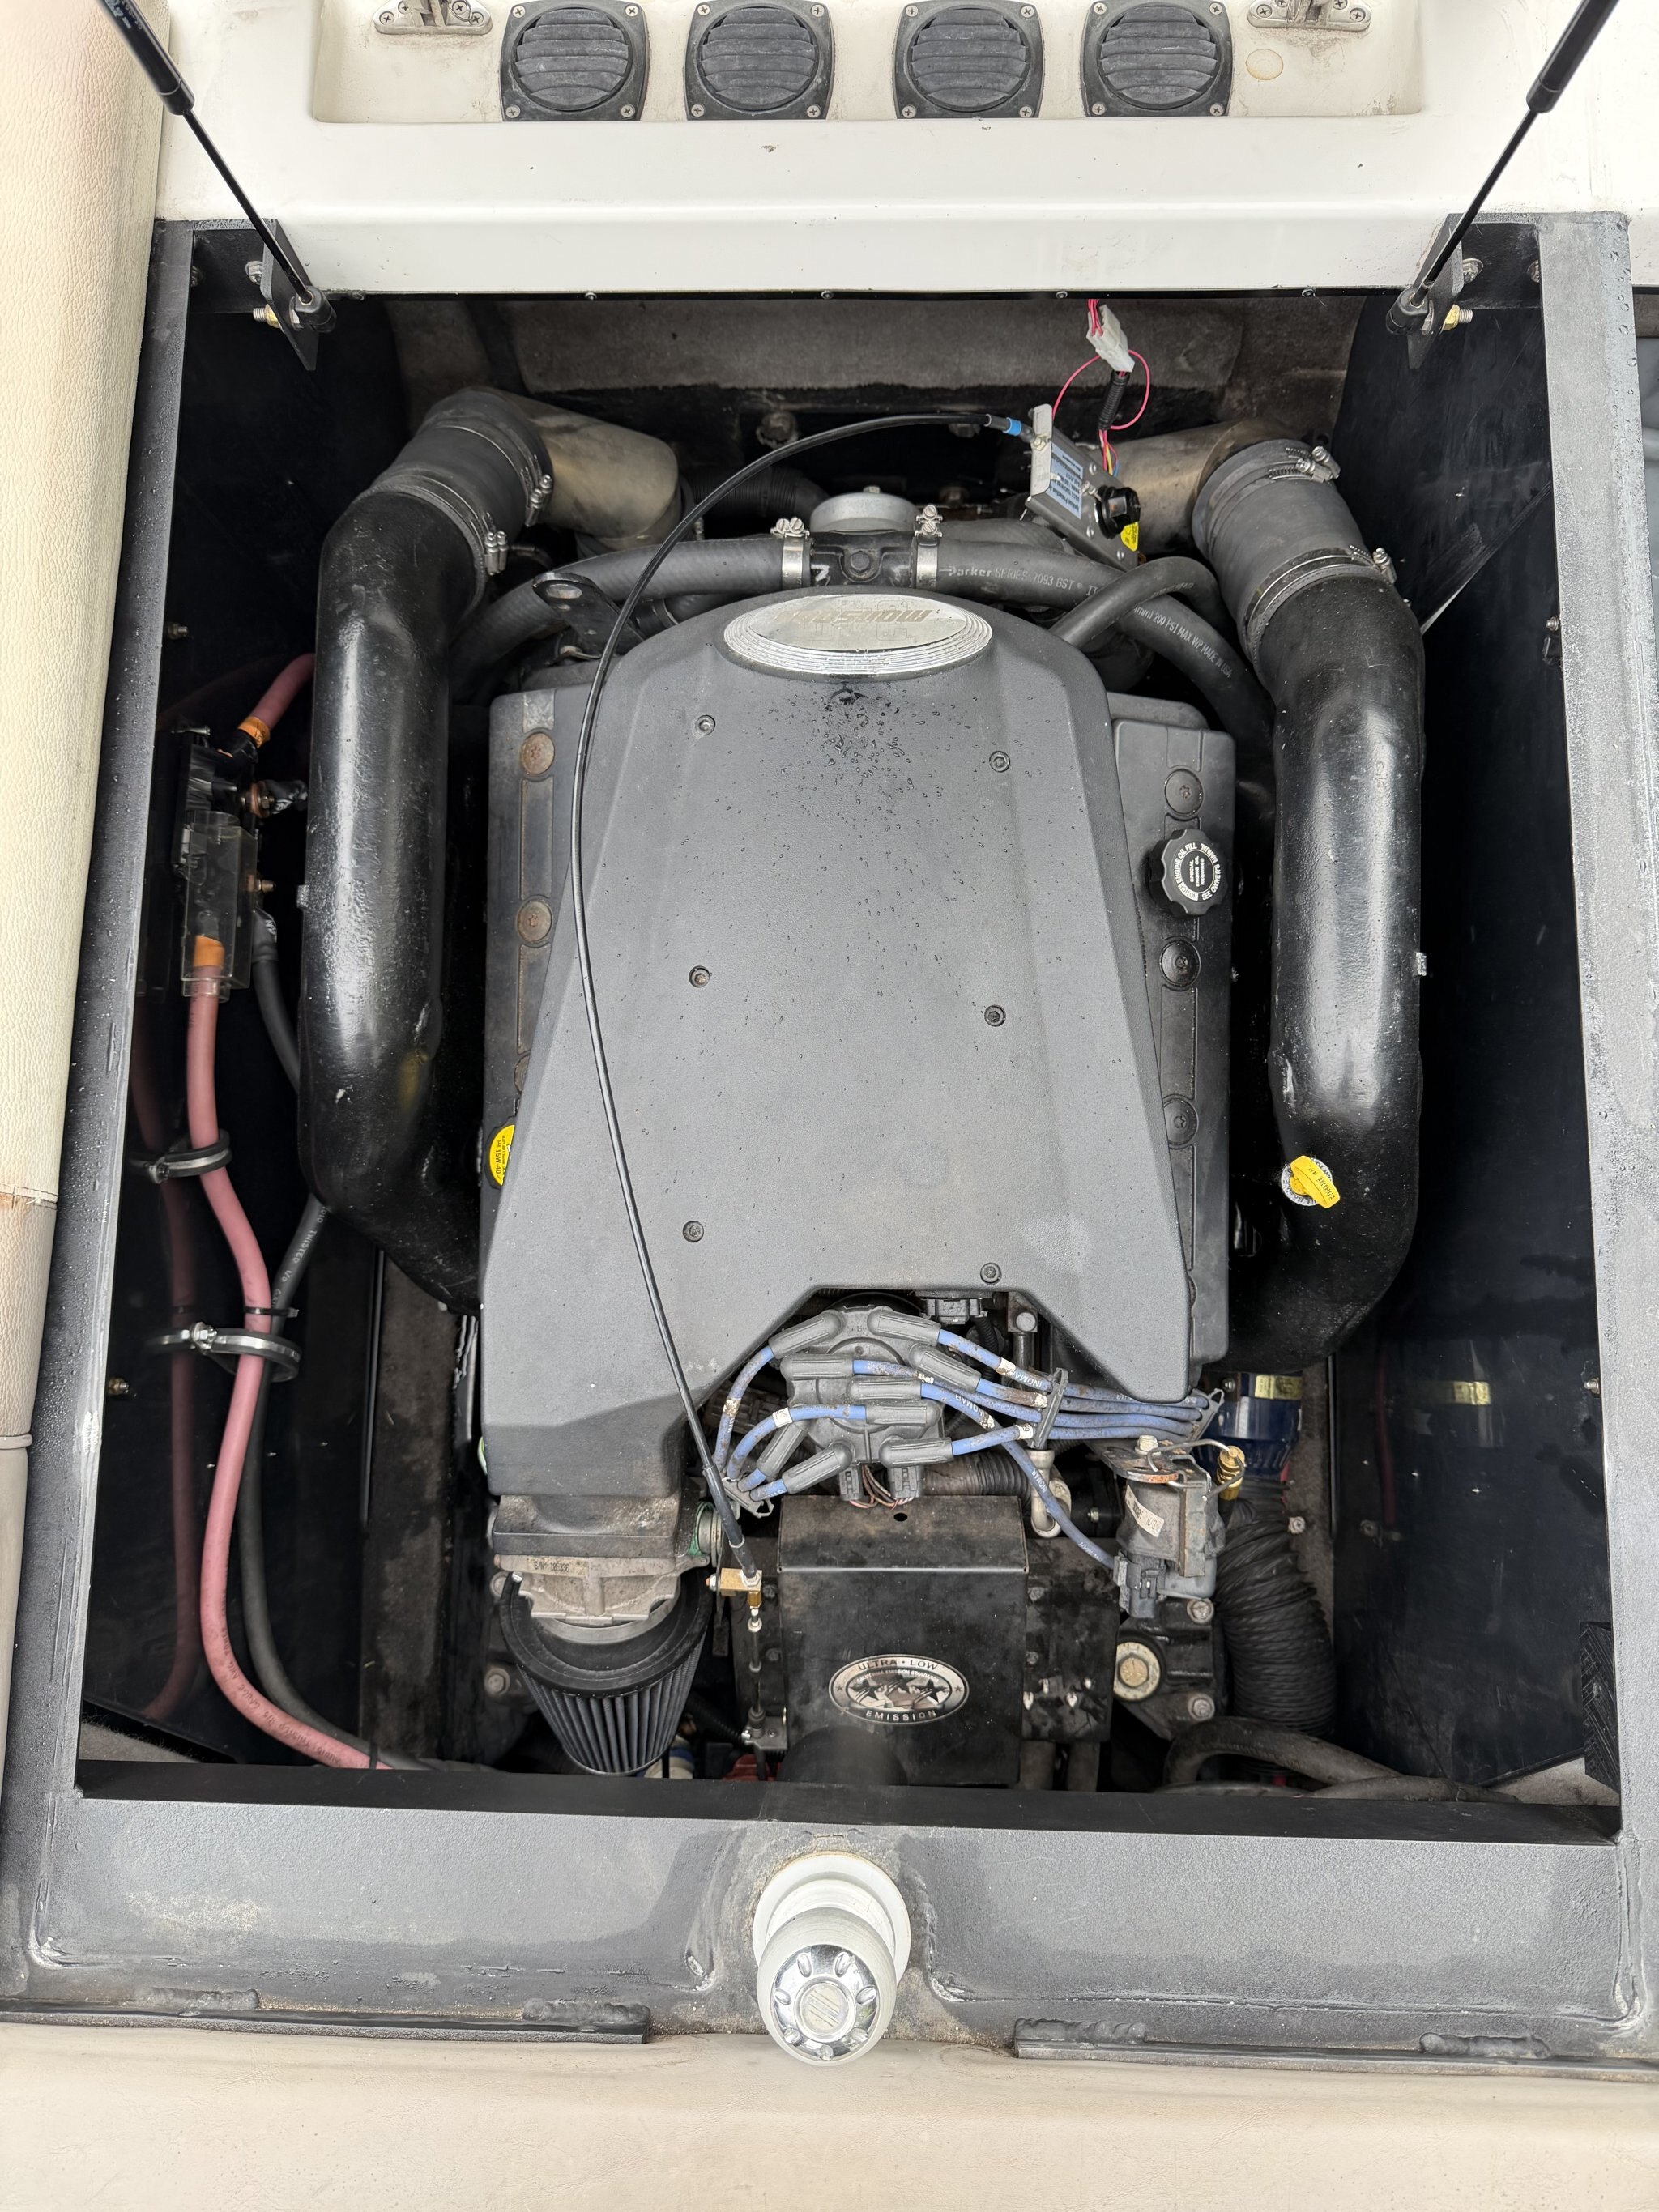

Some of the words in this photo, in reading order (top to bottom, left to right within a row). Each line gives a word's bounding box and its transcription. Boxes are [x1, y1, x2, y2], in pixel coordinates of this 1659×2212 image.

[949, 565, 992, 577] Parker
[995, 568, 1028, 582] SERIES
[1033, 572, 1054, 586] 7093
[1152, 612, 1166, 627] 200
[1164, 618, 1179, 634] PSI
[1176, 625, 1194, 643] MAX
[1200, 644, 1219, 664] MADE
[1220, 662, 1234, 679] USA
[1177, 849, 1187, 859] OIL
[1184, 842, 1197, 851] FILL
[1201, 843, 1218, 863] MANUAL
[1174, 858, 1183, 884] ENGINE
[1178, 882, 1198, 901] NOTICE
[1202, 893, 1213, 901] SEE
[292, 1230, 318, 1264] TWISTED
[857, 1658, 898, 1672] ULTRA
[909, 1659, 939, 1671] LOW
[865, 1709, 937, 1722] EMISSION
